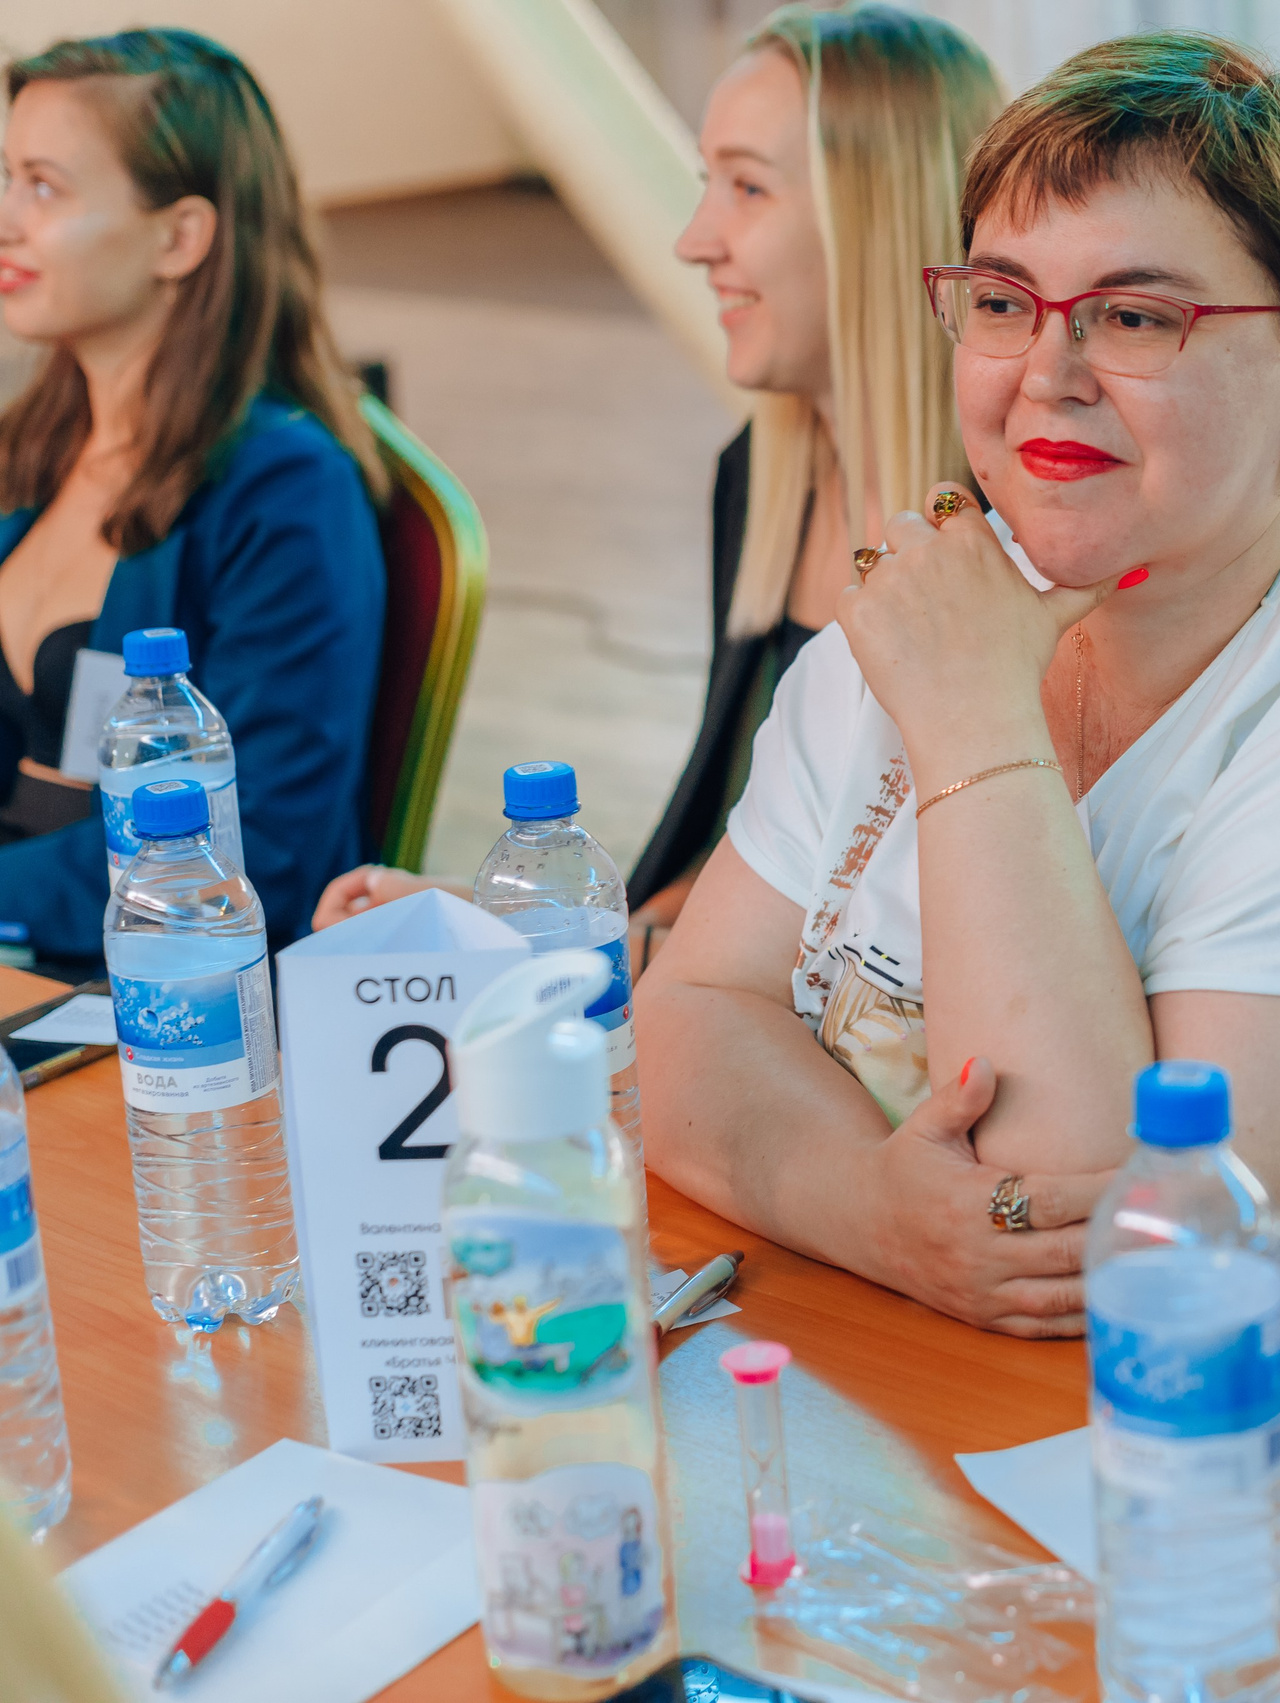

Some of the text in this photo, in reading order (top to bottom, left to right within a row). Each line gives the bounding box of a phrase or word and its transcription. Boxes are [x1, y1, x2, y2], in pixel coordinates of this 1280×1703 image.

[356, 975, 456, 1004] СТОЛ
[136, 1072, 178, 1089] ВОДА
[132, 1087, 189, 1098] негазированная
[371, 1023, 454, 1161] 2
[360, 1222, 442, 1235] Валентина
